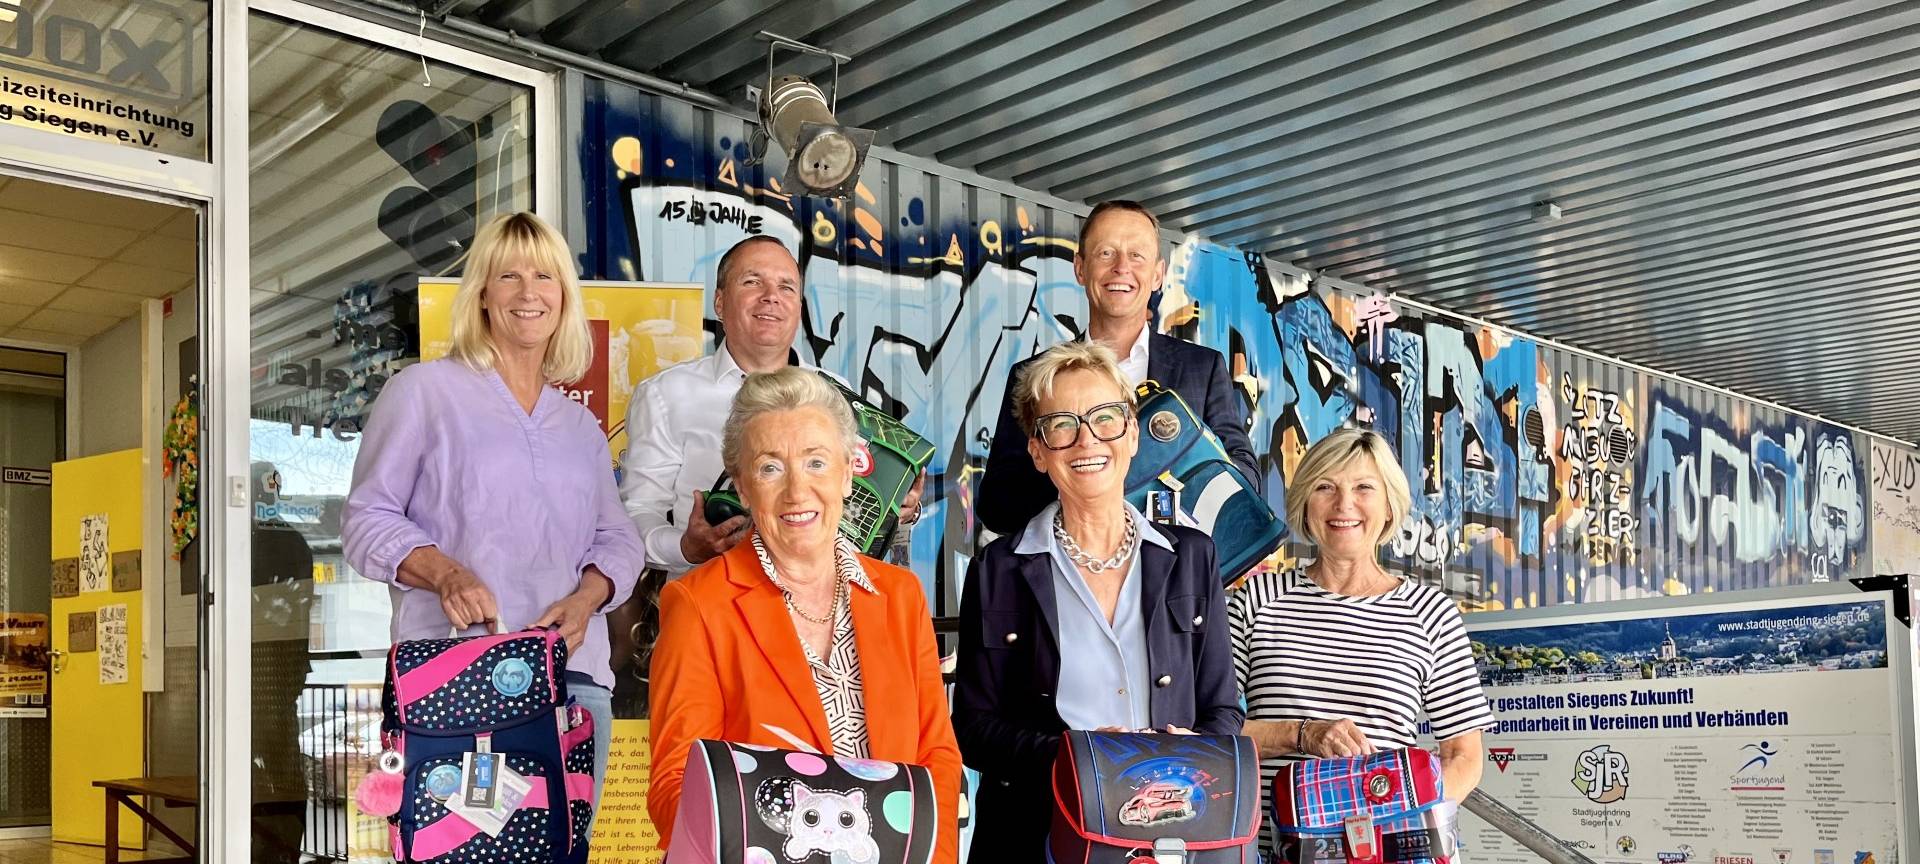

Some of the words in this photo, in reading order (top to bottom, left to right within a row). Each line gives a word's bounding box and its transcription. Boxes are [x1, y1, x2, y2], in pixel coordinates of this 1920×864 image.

[0, 77, 194, 138] izeiteinrichtung
[23, 105, 107, 137] Siegen
[116, 129, 158, 148] e.V.
[6, 471, 31, 481] BMZ
[1718, 612, 1869, 632] www.stadtjugendring-siegen.de
[1498, 694, 1564, 712] gestalten
[1567, 692, 1627, 709] Siegens
[1630, 688, 1694, 706] Zukunft!
[1572, 716, 1587, 731] in
[1590, 713, 1659, 731] Vereinen
[1663, 712, 1692, 729] und
[1695, 709, 1788, 728] Verbänden
[629, 736, 637, 744] in
[609, 750, 625, 758] eck,
[630, 750, 645, 758] das
[606, 763, 618, 771] nd
[621, 763, 651, 771] Familie
[622, 777, 650, 785] Person
[1730, 774, 1785, 786] Sportjugend
[601, 803, 641, 811] werdende
[1572, 808, 1631, 819] Stadtjugendring
[597, 817, 611, 825] mit
[615, 817, 637, 825] ihren
[1580, 818, 1607, 828] Siegen
[591, 831, 606, 839] Ziel
[610, 831, 620, 839] ist
[641, 830, 654, 839] bei
[589, 844, 612, 853] higen
